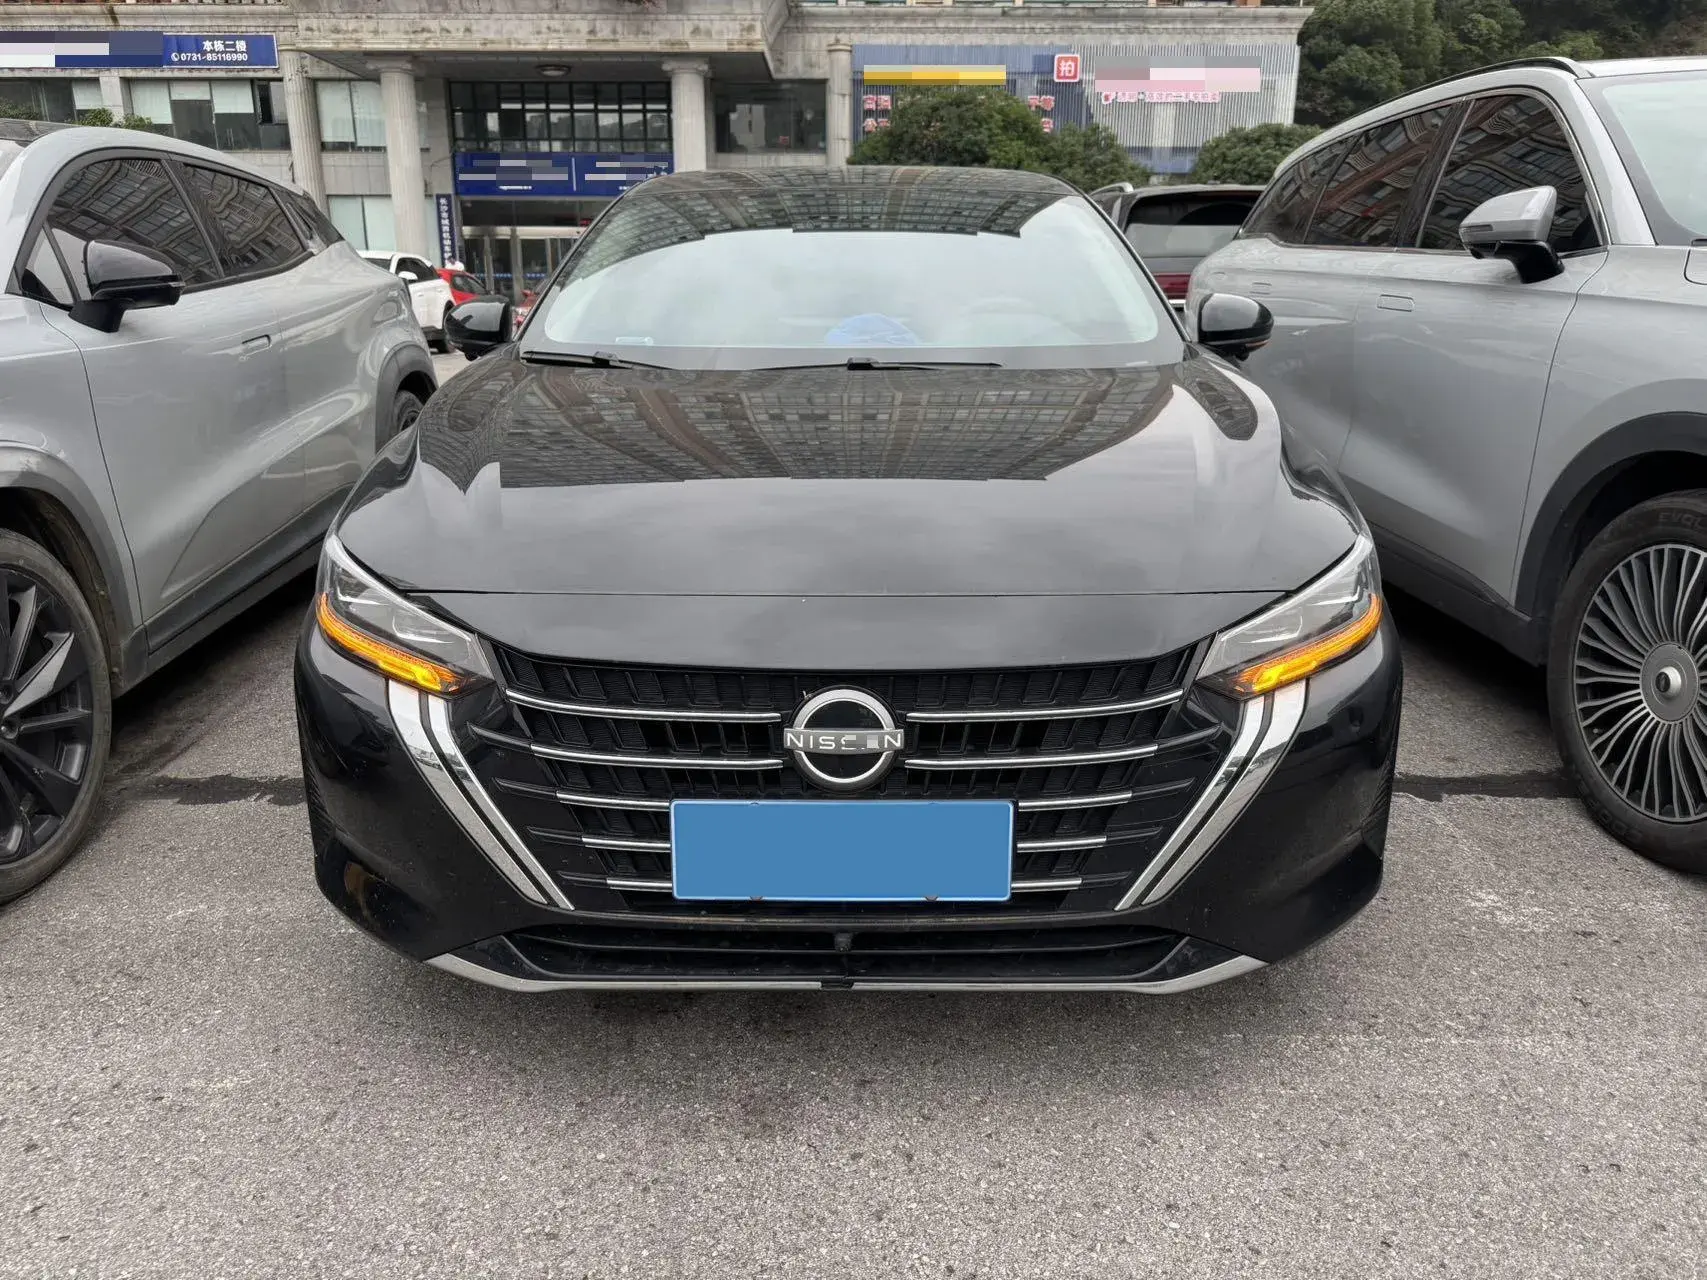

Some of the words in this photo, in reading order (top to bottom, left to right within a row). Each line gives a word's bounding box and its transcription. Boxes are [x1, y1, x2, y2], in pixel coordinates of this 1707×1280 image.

[203, 40, 246, 51] 本栋二楼
[786, 733, 901, 749] NISN
